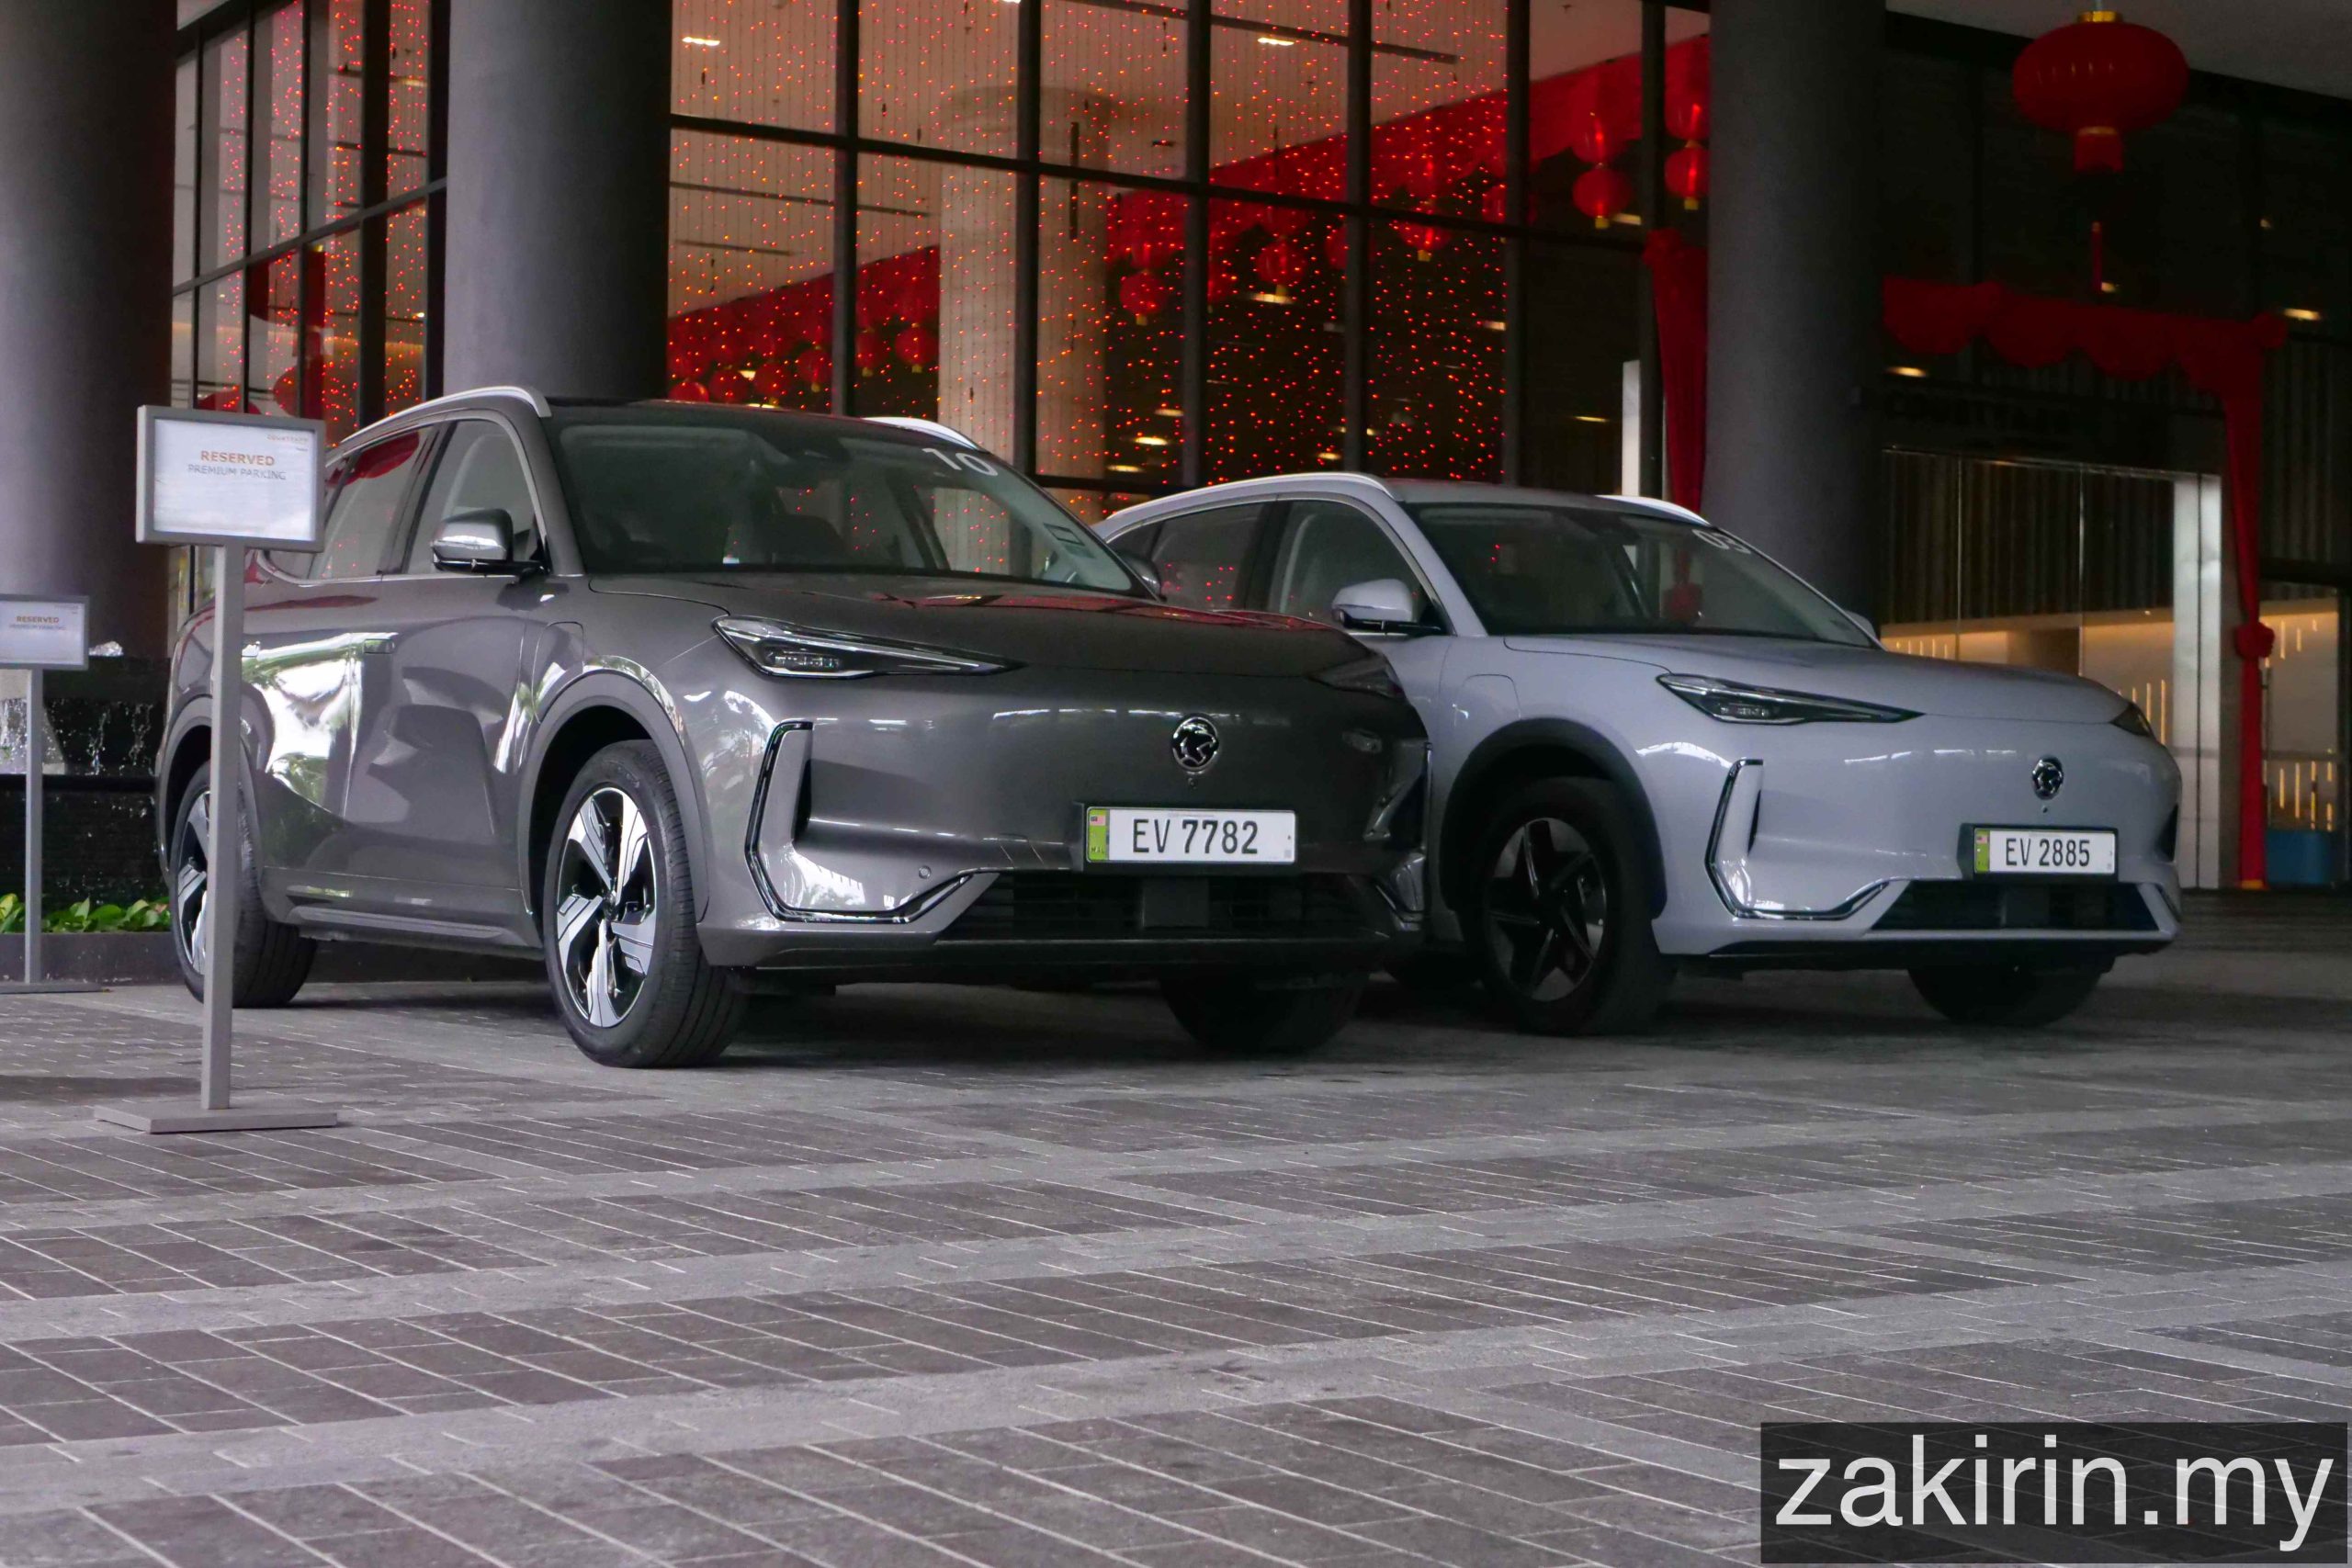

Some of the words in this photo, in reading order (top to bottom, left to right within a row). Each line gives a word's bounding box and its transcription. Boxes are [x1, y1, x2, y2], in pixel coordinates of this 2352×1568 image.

[200, 450, 275, 467] RESERVED
[922, 447, 999, 476] 10
[187, 464, 237, 476] PREMIUM
[240, 468, 287, 480] PARKING
[16, 615, 60, 624] RESERVED
[1133, 818, 1170, 853] EV
[1182, 819, 1259, 854] 7782
[2006, 838, 2031, 866] EV
[2039, 839, 2090, 867] 2885
